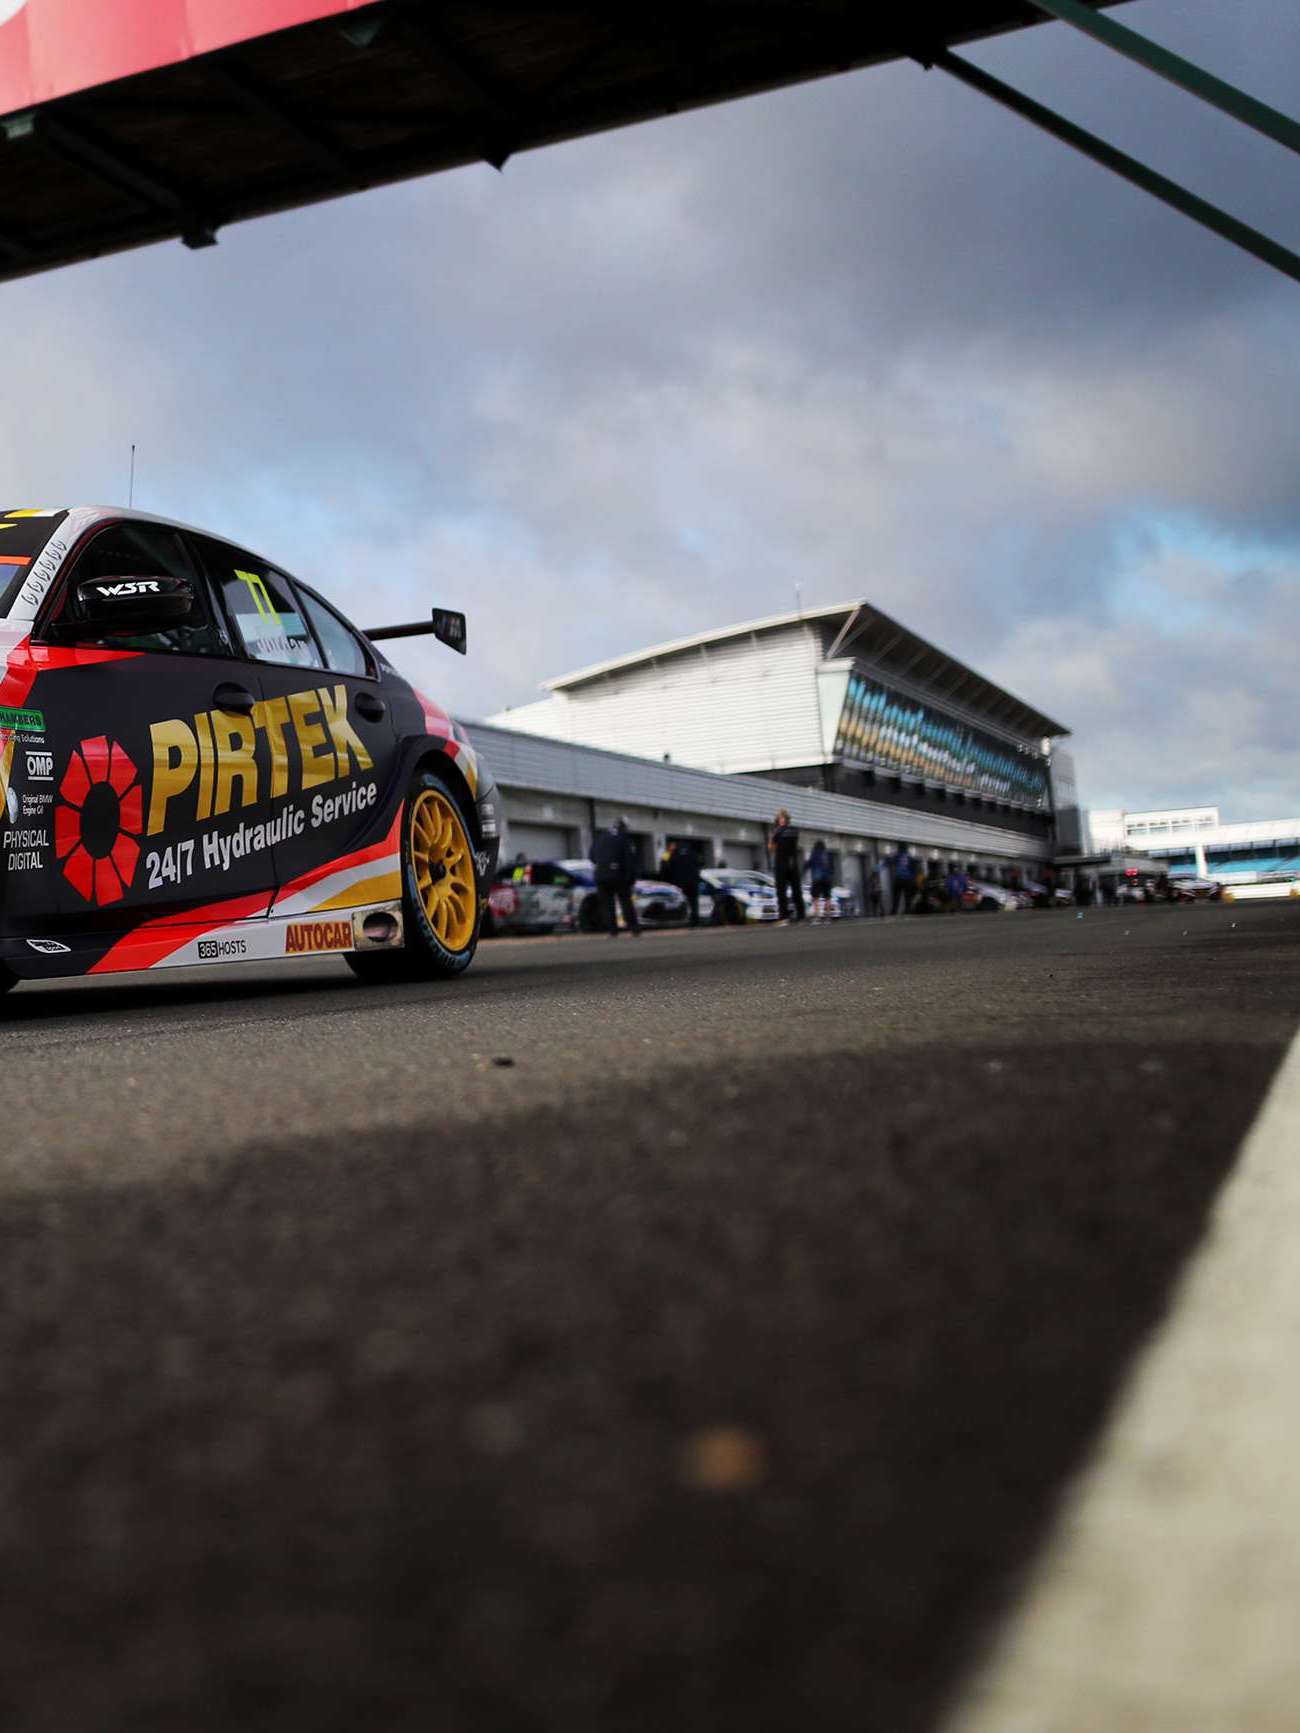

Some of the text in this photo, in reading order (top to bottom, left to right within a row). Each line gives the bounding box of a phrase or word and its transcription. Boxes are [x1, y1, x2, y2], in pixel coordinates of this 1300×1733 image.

[96, 581, 160, 597] WSR
[234, 569, 281, 625] 77
[27, 756, 53, 776] OMP
[147, 684, 374, 836] PIRTEK
[3, 829, 49, 849] PHYSICAL
[146, 781, 377, 889] 24/7 Hydraulic Service
[8, 851, 43, 871] DIGITAL
[285, 921, 352, 952] AUTOCAR
